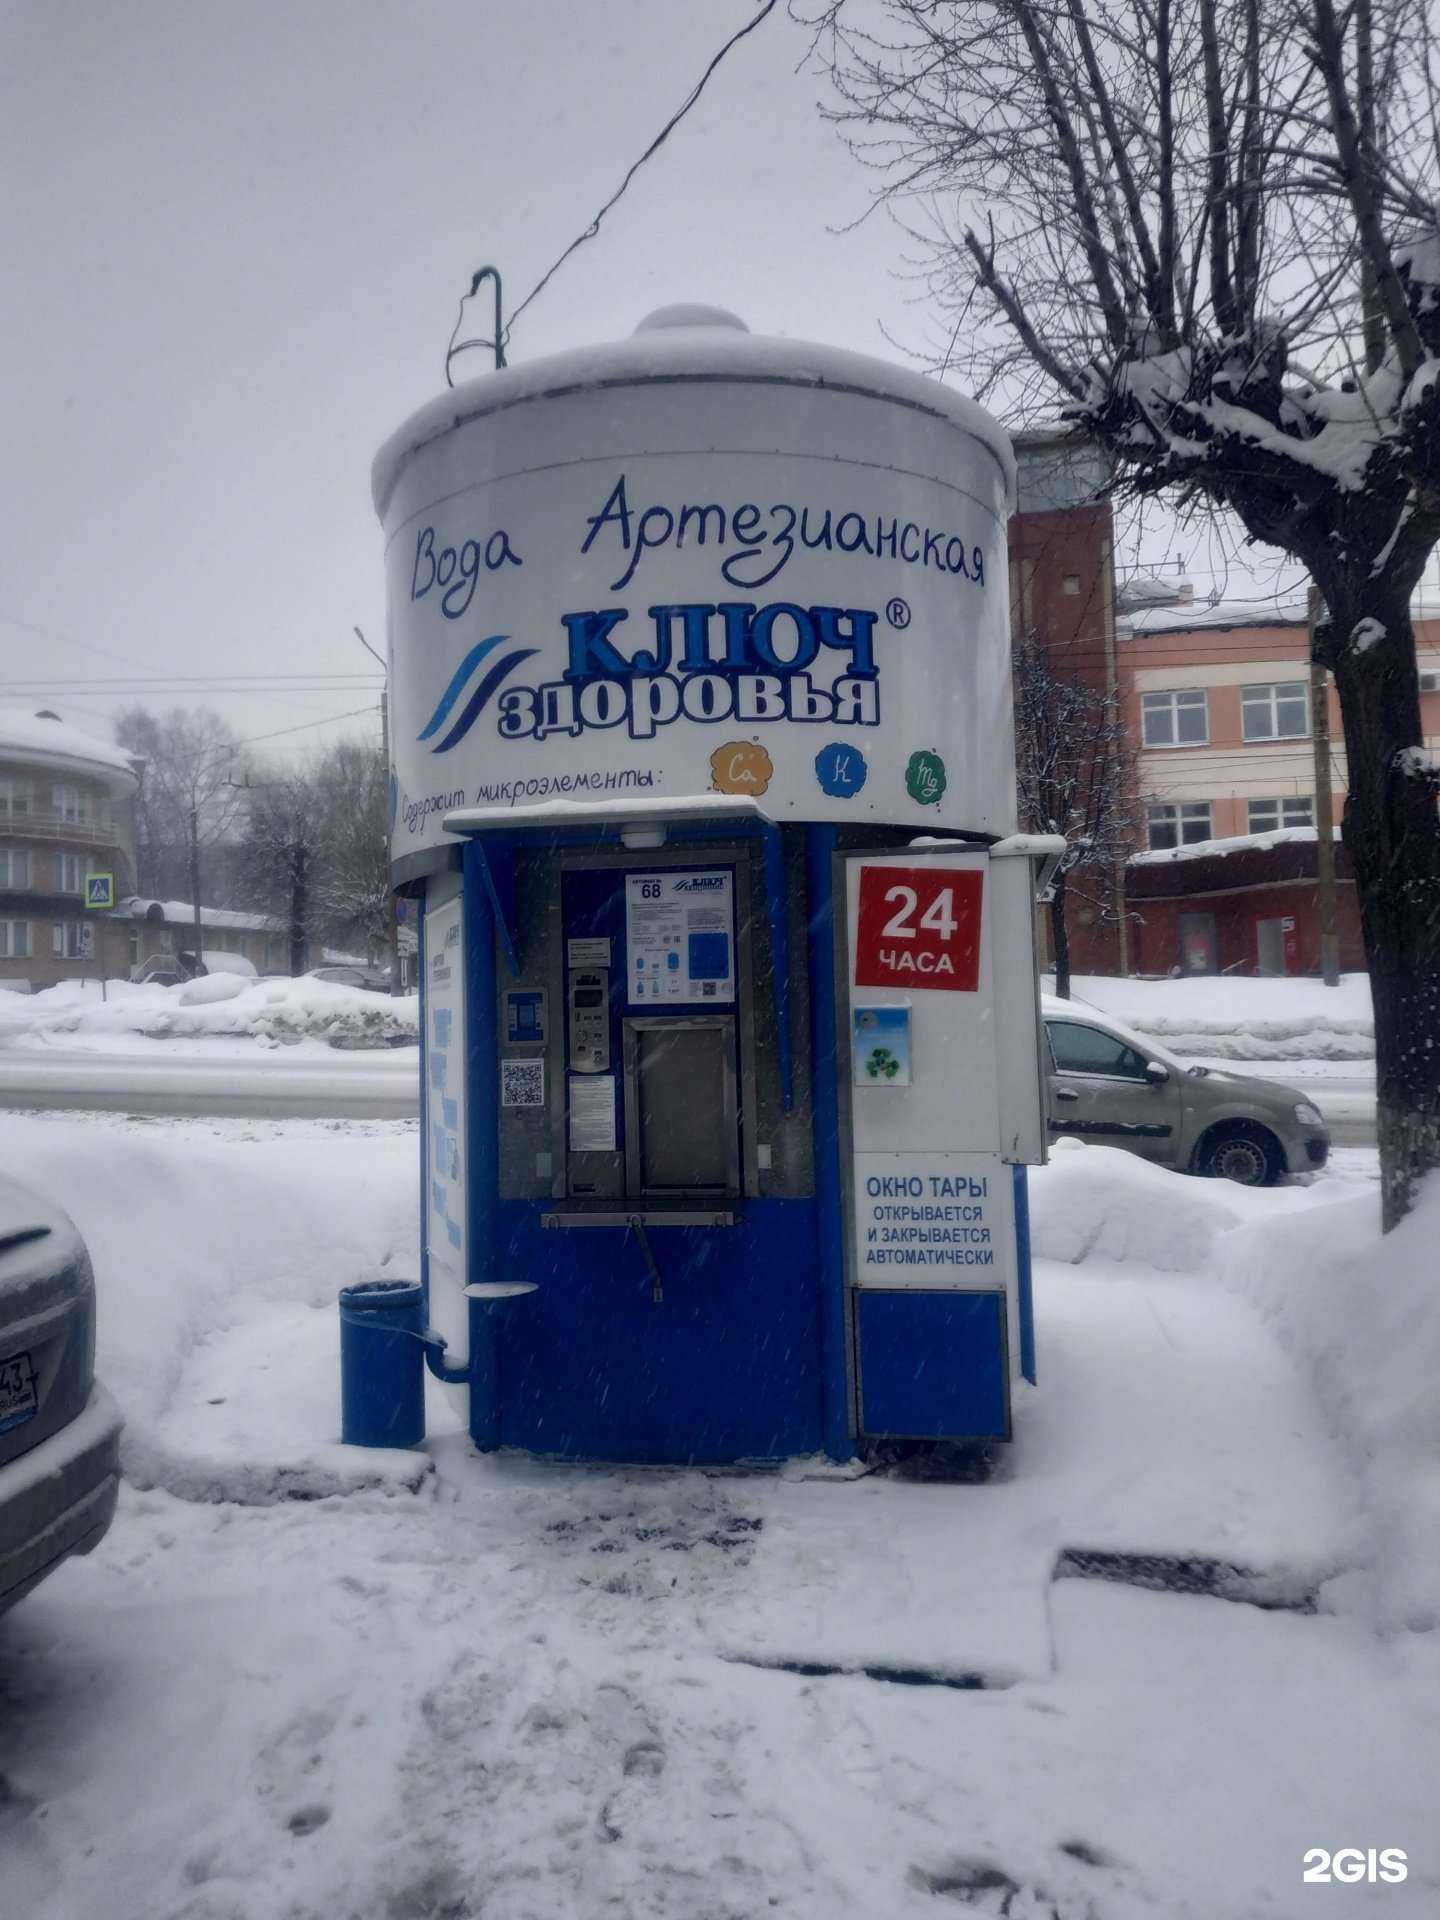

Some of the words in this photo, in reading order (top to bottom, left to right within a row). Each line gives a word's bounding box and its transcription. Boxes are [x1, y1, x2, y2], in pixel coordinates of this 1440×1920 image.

[411, 525, 523, 620] Вода
[580, 474, 987, 592] Артезианская
[728, 752, 757, 781] Ca
[917, 758, 938, 797] Mg
[401, 787, 466, 836] Содержит
[476, 769, 664, 807] микроэлементы:
[642, 884, 661, 899] 68
[881, 885, 958, 940] 24
[879, 949, 955, 974] ЧАСА
[866, 1176, 923, 1198] ОКНО
[928, 1176, 987, 1198] ТАРЫ
[873, 1205, 983, 1221] ОТКРЫВАЕТСЯ
[868, 1227, 877, 1242] И
[881, 1227, 991, 1243] ЗАКРЫВАЕТСЯ
[866, 1249, 994, 1265] АВТОМАТИЧЕСКИ
